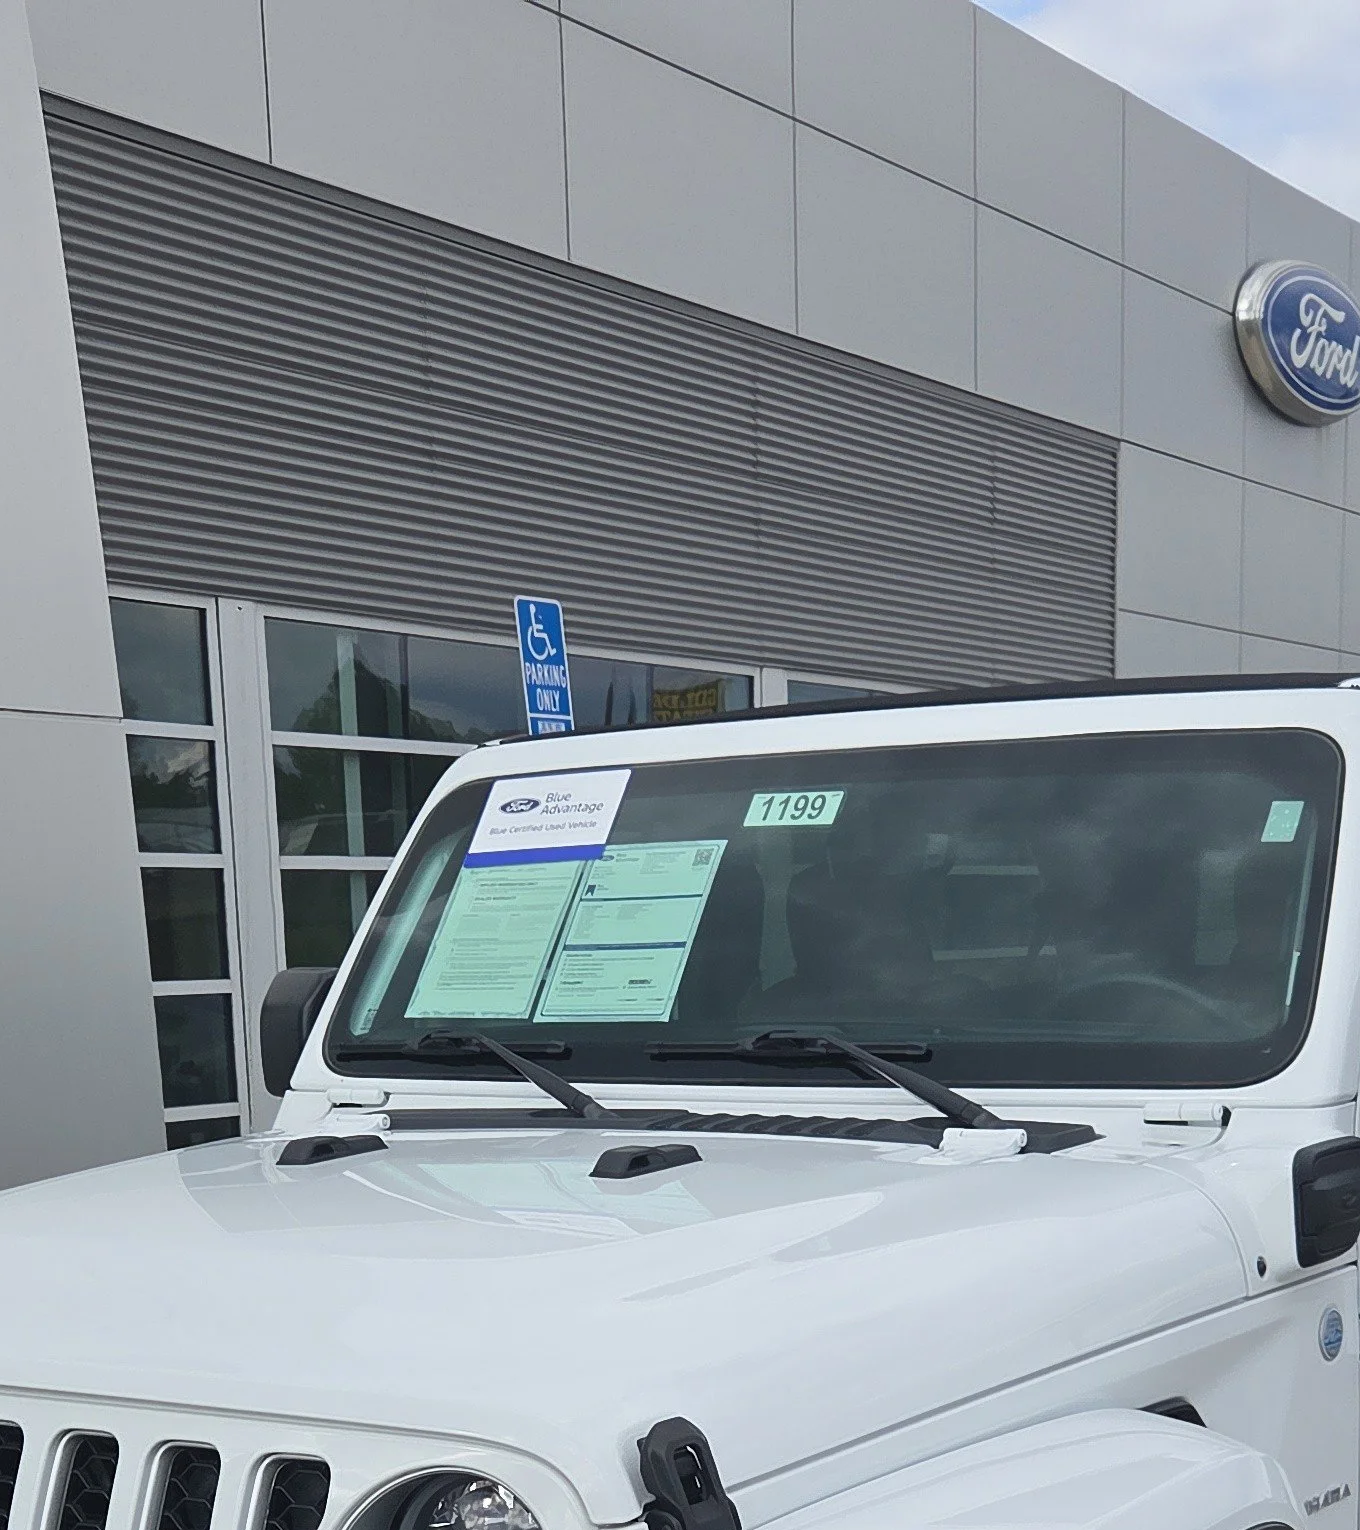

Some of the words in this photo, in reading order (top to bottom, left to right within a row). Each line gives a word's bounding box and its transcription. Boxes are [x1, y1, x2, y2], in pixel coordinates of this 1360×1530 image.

[1290, 293, 1360, 389] Ford
[525, 662, 567, 688] PARKING
[536, 687, 560, 712] ONLY
[540, 801, 605, 815] Advantage
[546, 792, 572, 803] Blue
[762, 794, 827, 821] 1199
[489, 826, 507, 836] Blue
[509, 824, 543, 834] Certified
[545, 822, 566, 831] Used
[567, 820, 597, 830] Vehicle
